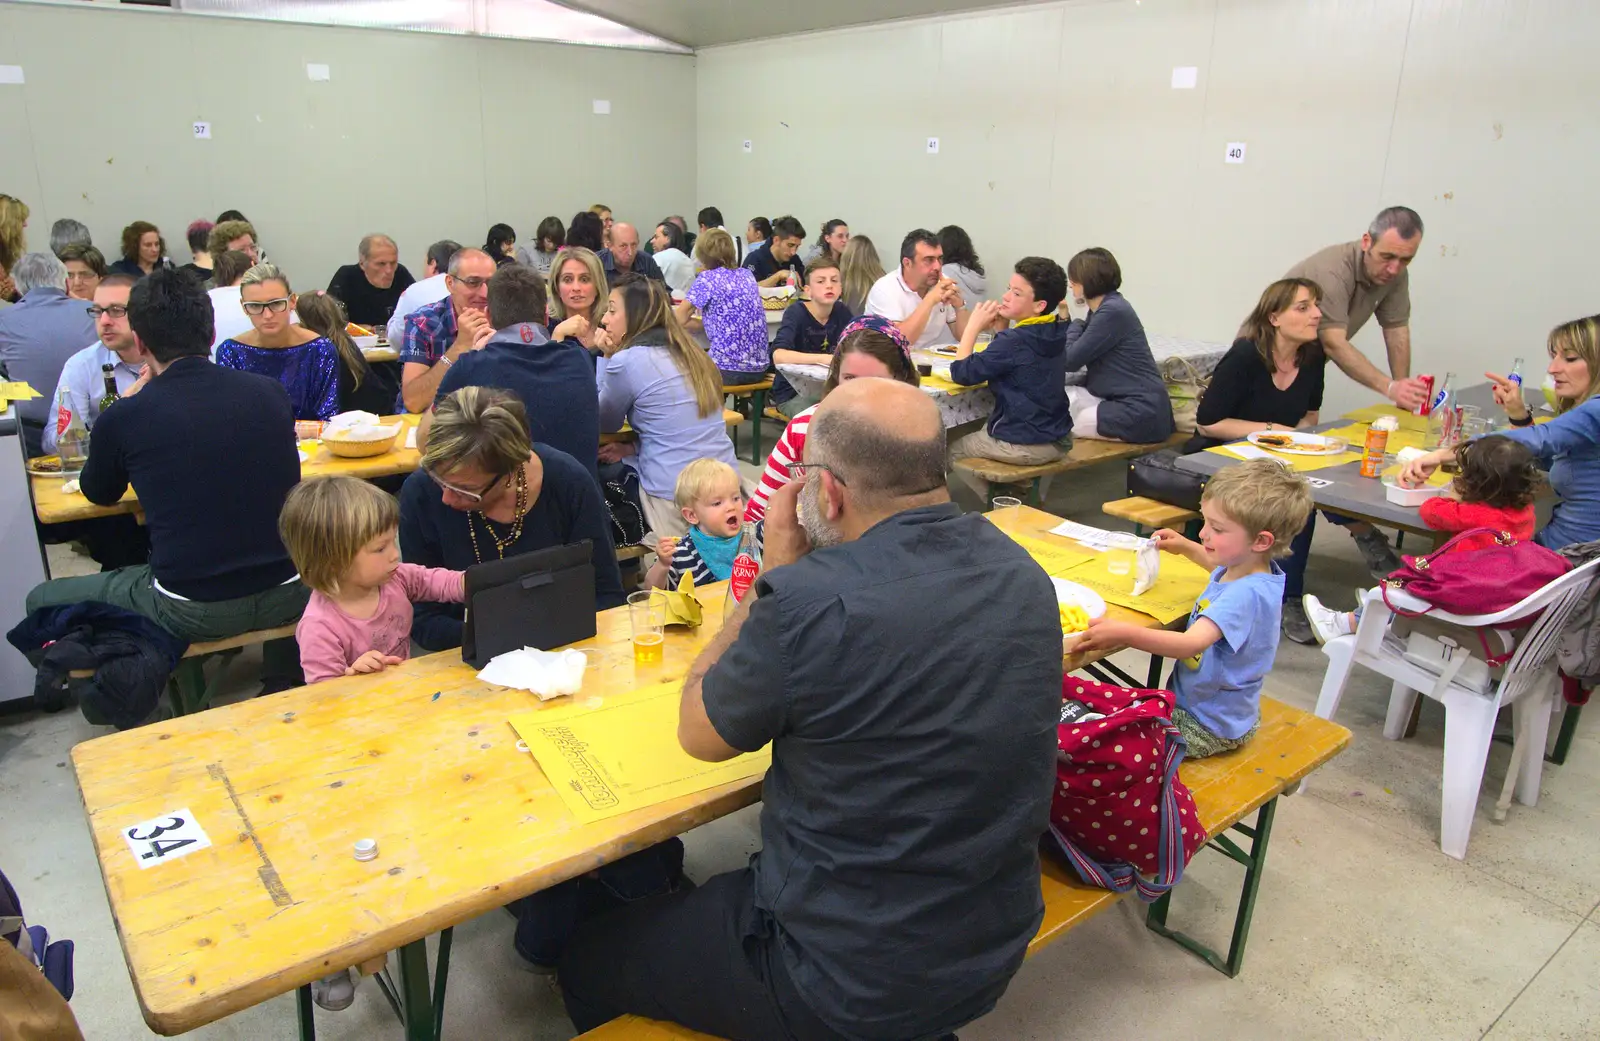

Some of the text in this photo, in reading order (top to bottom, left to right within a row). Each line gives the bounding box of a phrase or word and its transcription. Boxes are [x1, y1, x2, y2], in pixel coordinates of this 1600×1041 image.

[194, 125, 205, 134] 37
[929, 140, 936, 149] 41
[1229, 148, 1242, 159] 40
[127, 816, 198, 860] 34
